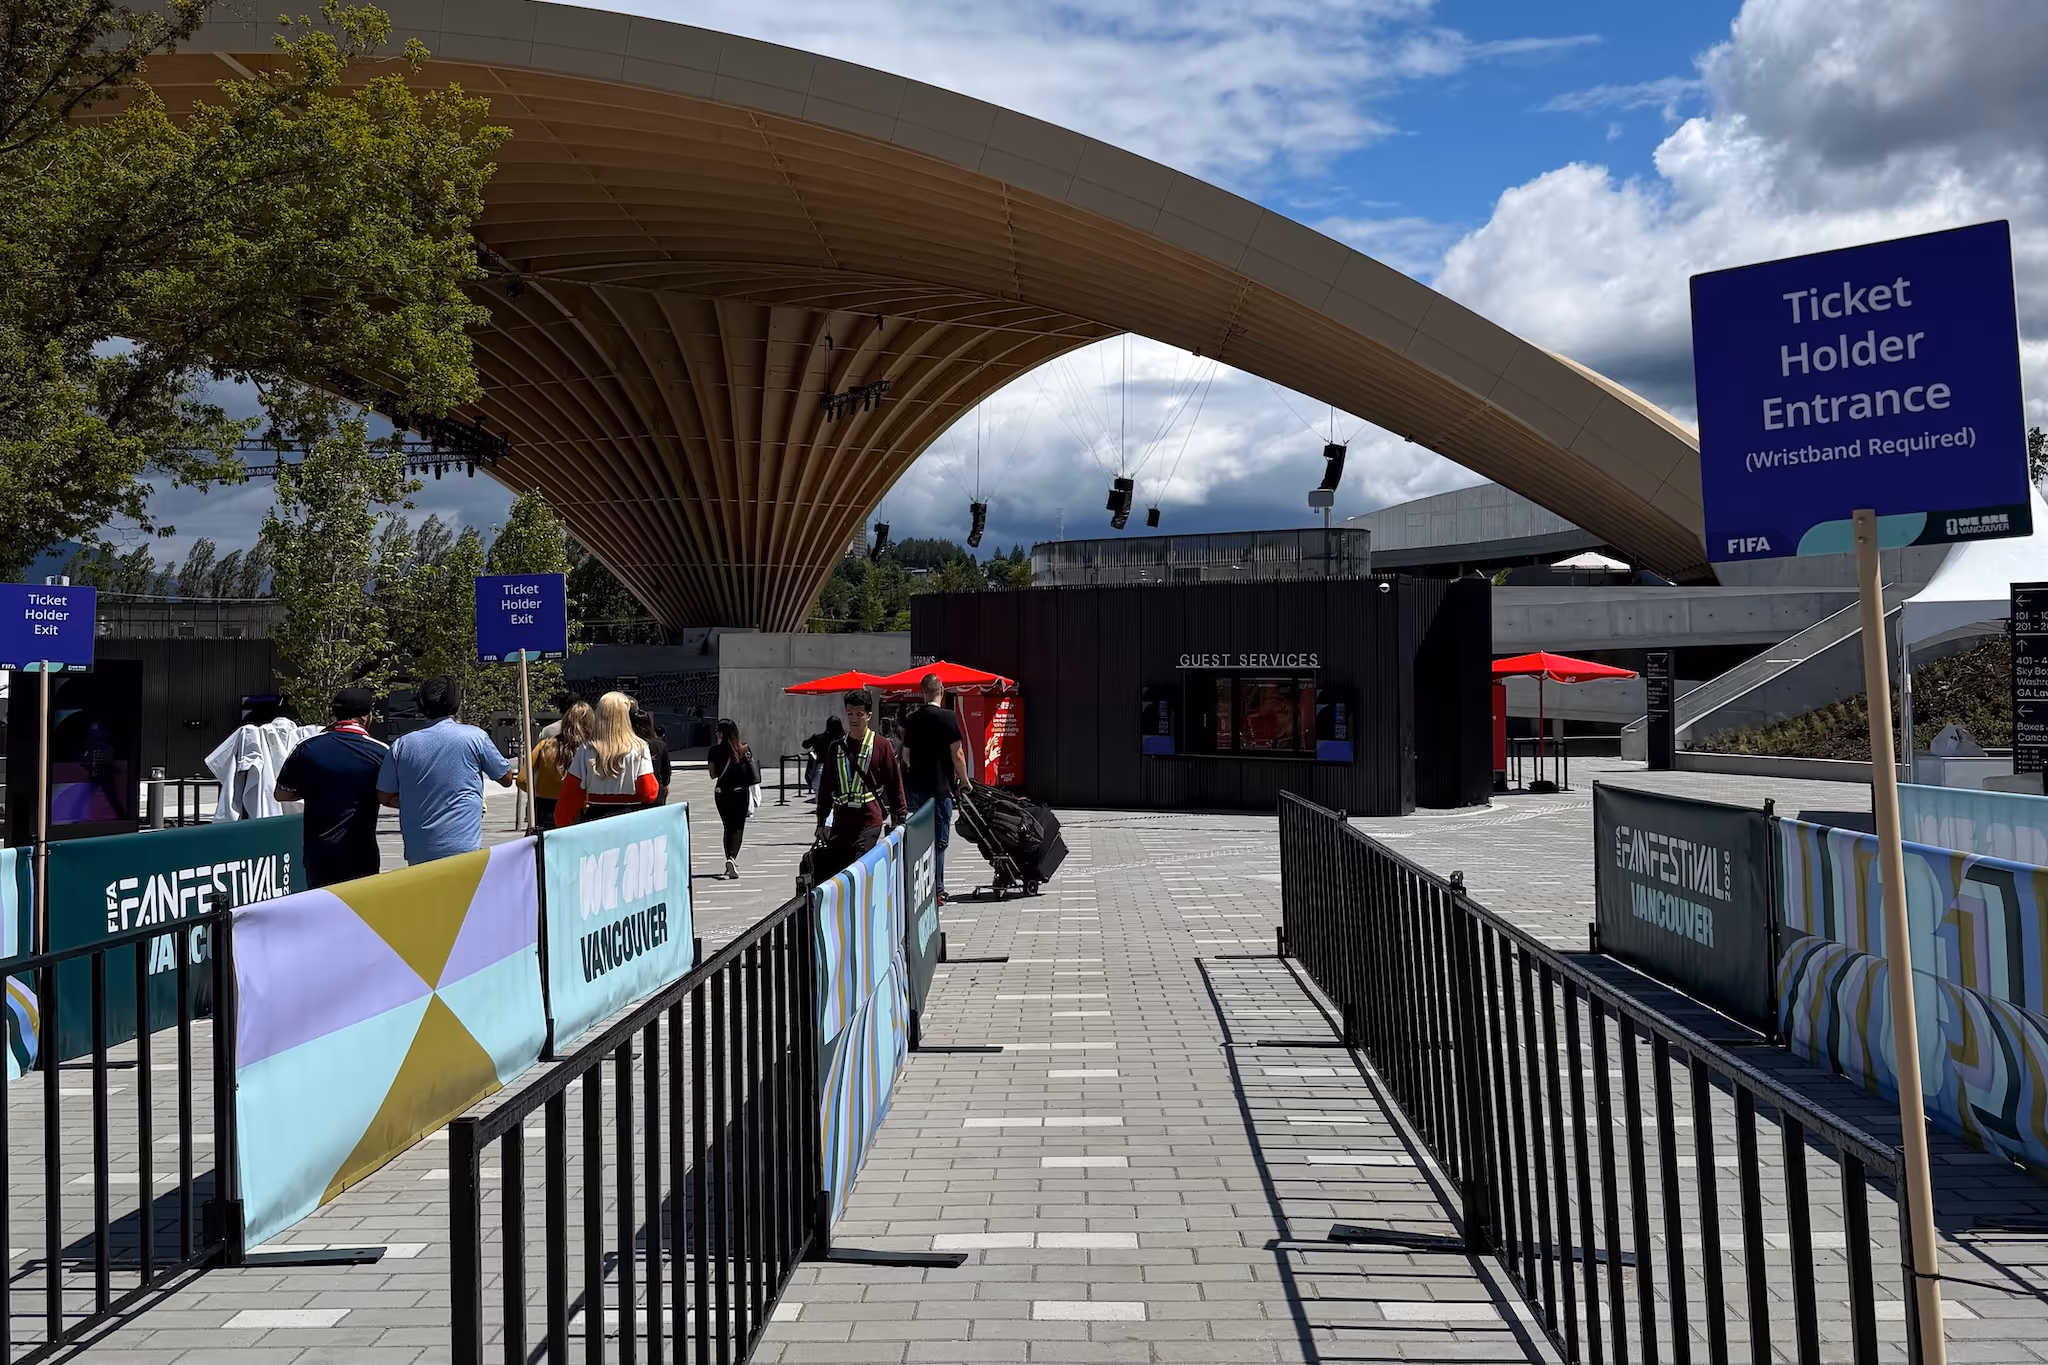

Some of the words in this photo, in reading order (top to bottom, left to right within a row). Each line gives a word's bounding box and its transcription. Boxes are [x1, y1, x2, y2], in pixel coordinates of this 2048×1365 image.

[1783, 277, 1912, 324] Ticket
[1781, 330, 1925, 377] Holder
[1763, 382, 1952, 431] Entrance
[1746, 438, 1863, 473] (Wristband
[1868, 427, 1977, 457] Required)
[1959, 522, 2010, 535] VANCOUVER
[1728, 537, 1771, 554] FIFA
[503, 584, 539, 595] Ticket
[27, 594, 68, 606] Ticket
[501, 599, 542, 610] Holder
[25, 609, 69, 621] Holder
[511, 614, 534, 625] Exit
[34, 624, 58, 636] Exit
[2015, 622, 2031, 631] 201
[1179, 653, 1231, 667] GUEST
[1239, 653, 1319, 667] SERVICES
[2016, 656, 2033, 665] 401
[2016, 667, 2033, 677] Sky
[2016, 689, 2032, 697] GA
[2017, 722, 2045, 731] Boxes
[579, 847, 620, 921] WE
[622, 834, 668, 904] ARE
[105, 880, 119, 934] FIFA
[1631, 881, 1714, 949] VANCOUVER
[580, 902, 668, 983] VANCOUVER
